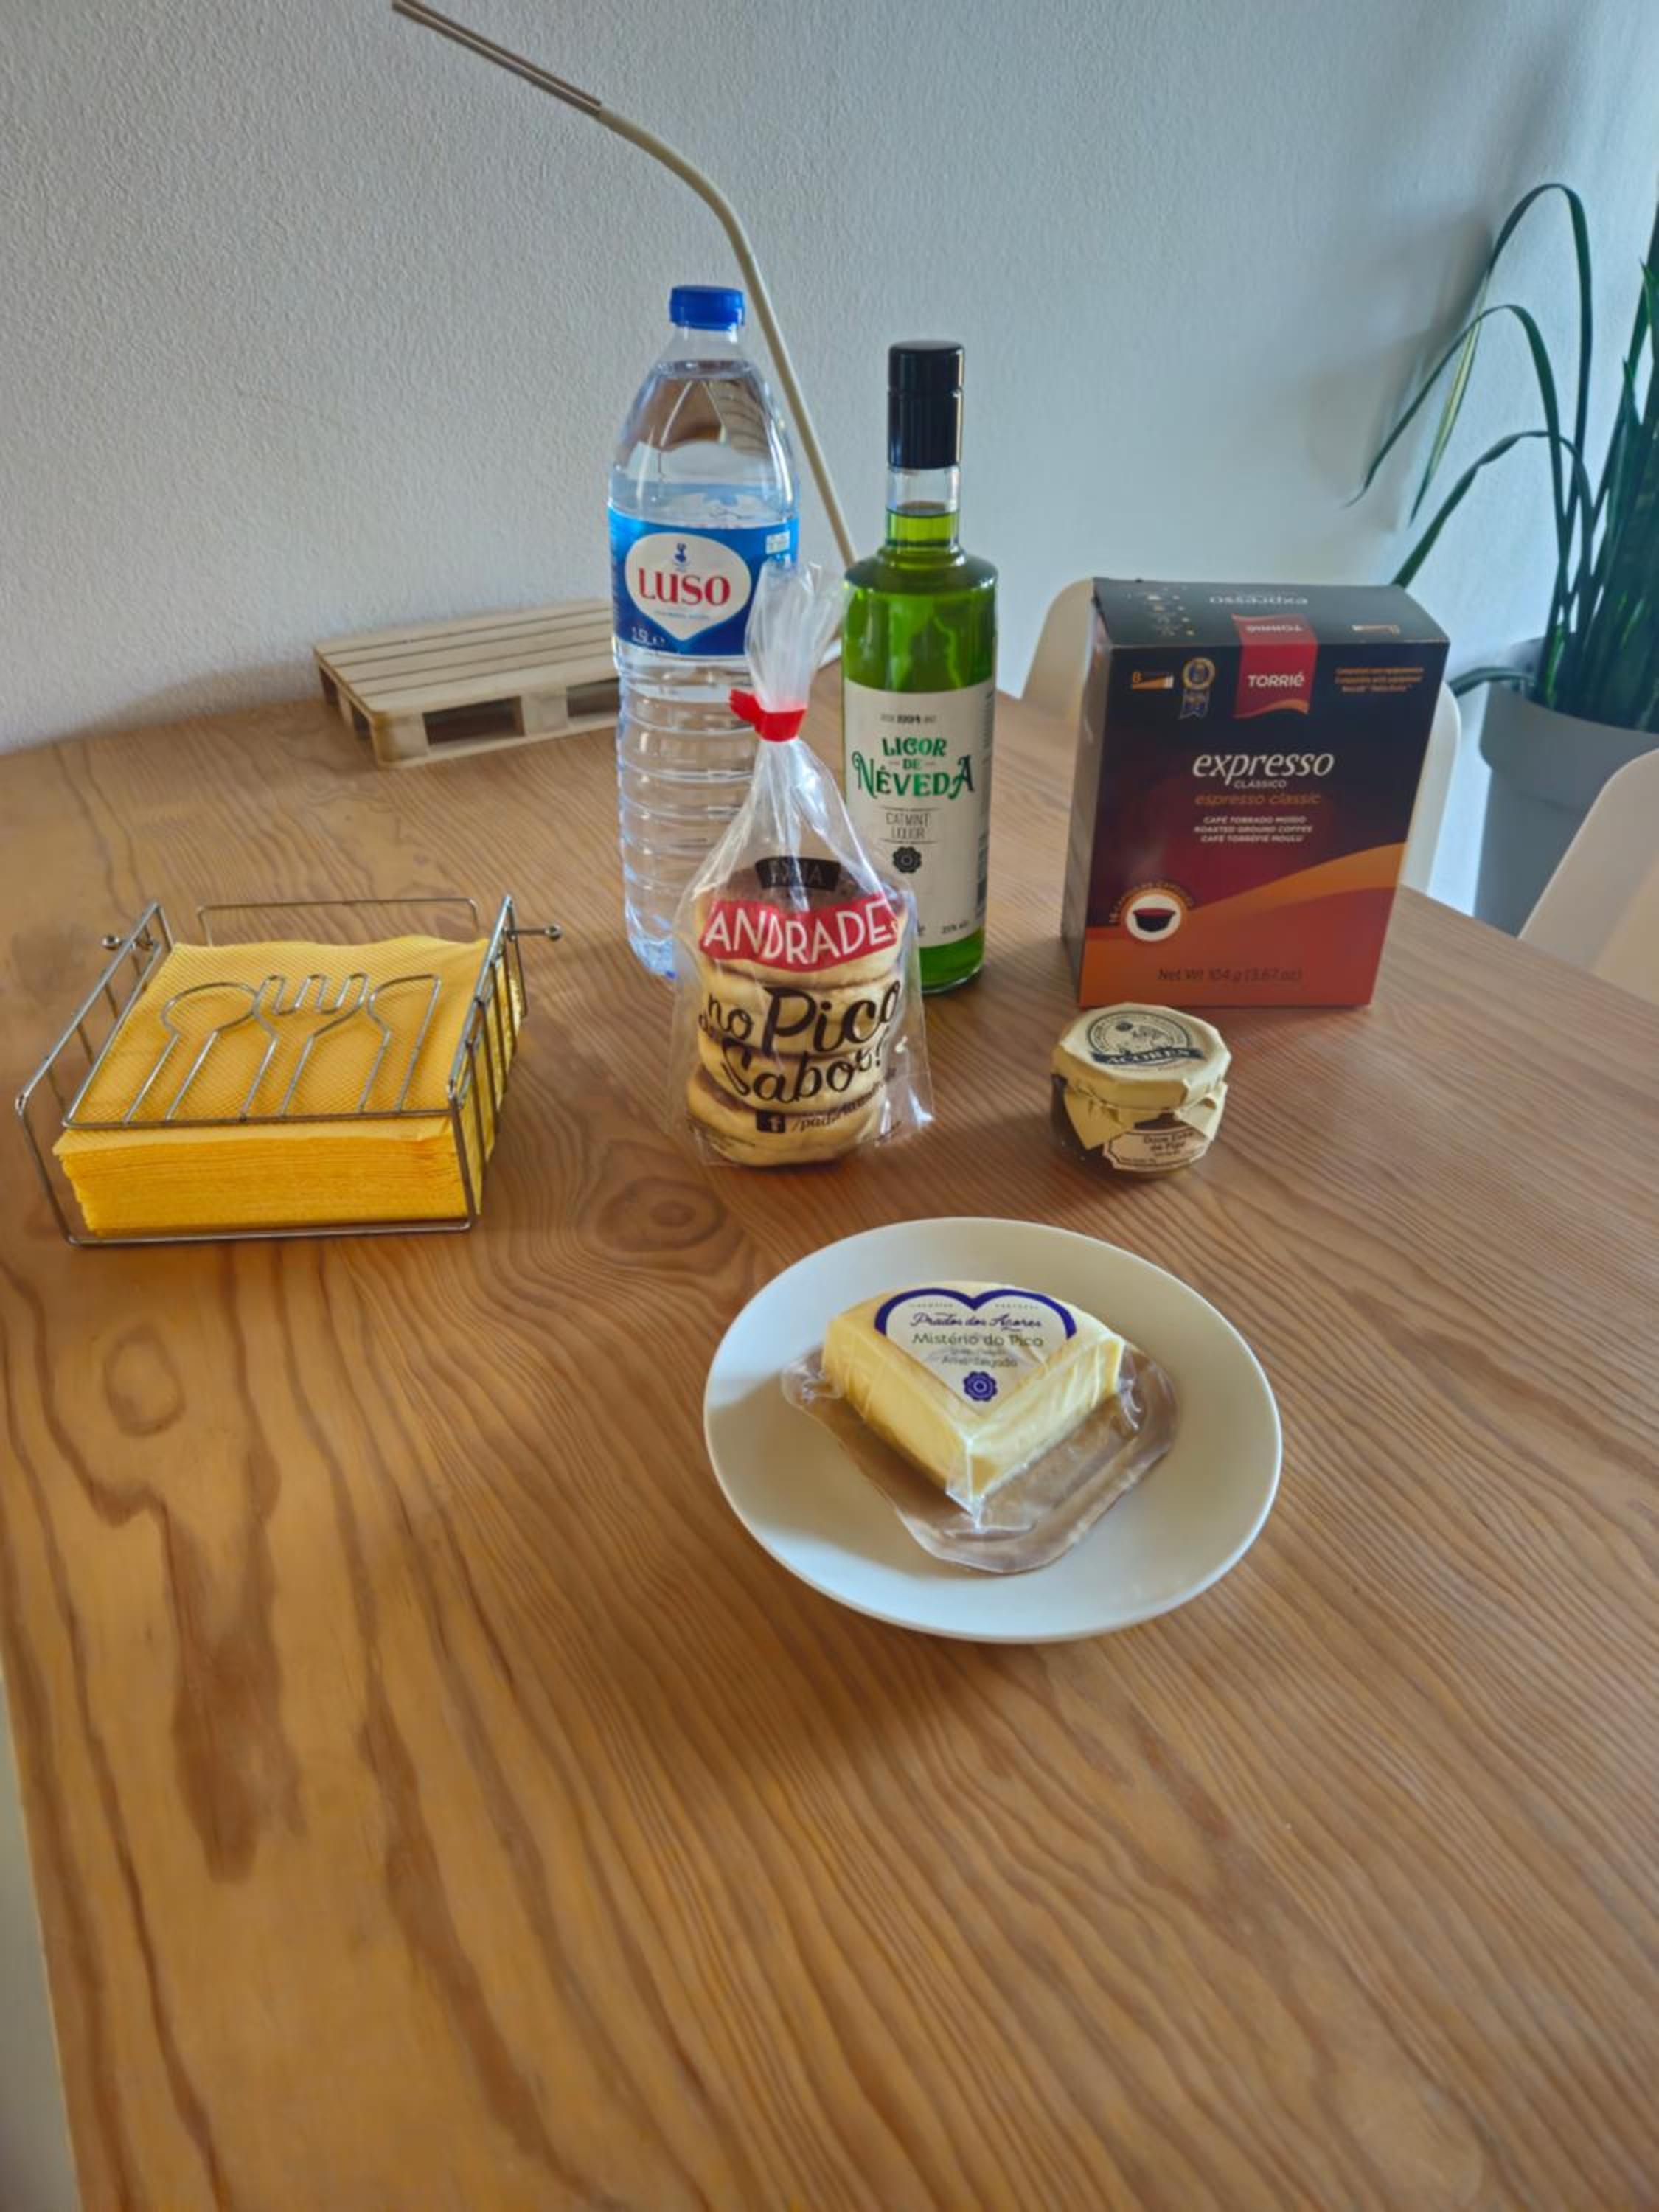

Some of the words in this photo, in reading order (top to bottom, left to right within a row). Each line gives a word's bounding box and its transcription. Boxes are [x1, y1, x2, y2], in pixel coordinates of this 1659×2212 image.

[639, 567, 731, 607] LUSO
[1192, 752, 1335, 787] expresso
[911, 1332, 981, 1346] Mistério
[982, 1333, 1005, 1347] do
[1008, 1332, 1045, 1348] Pico
